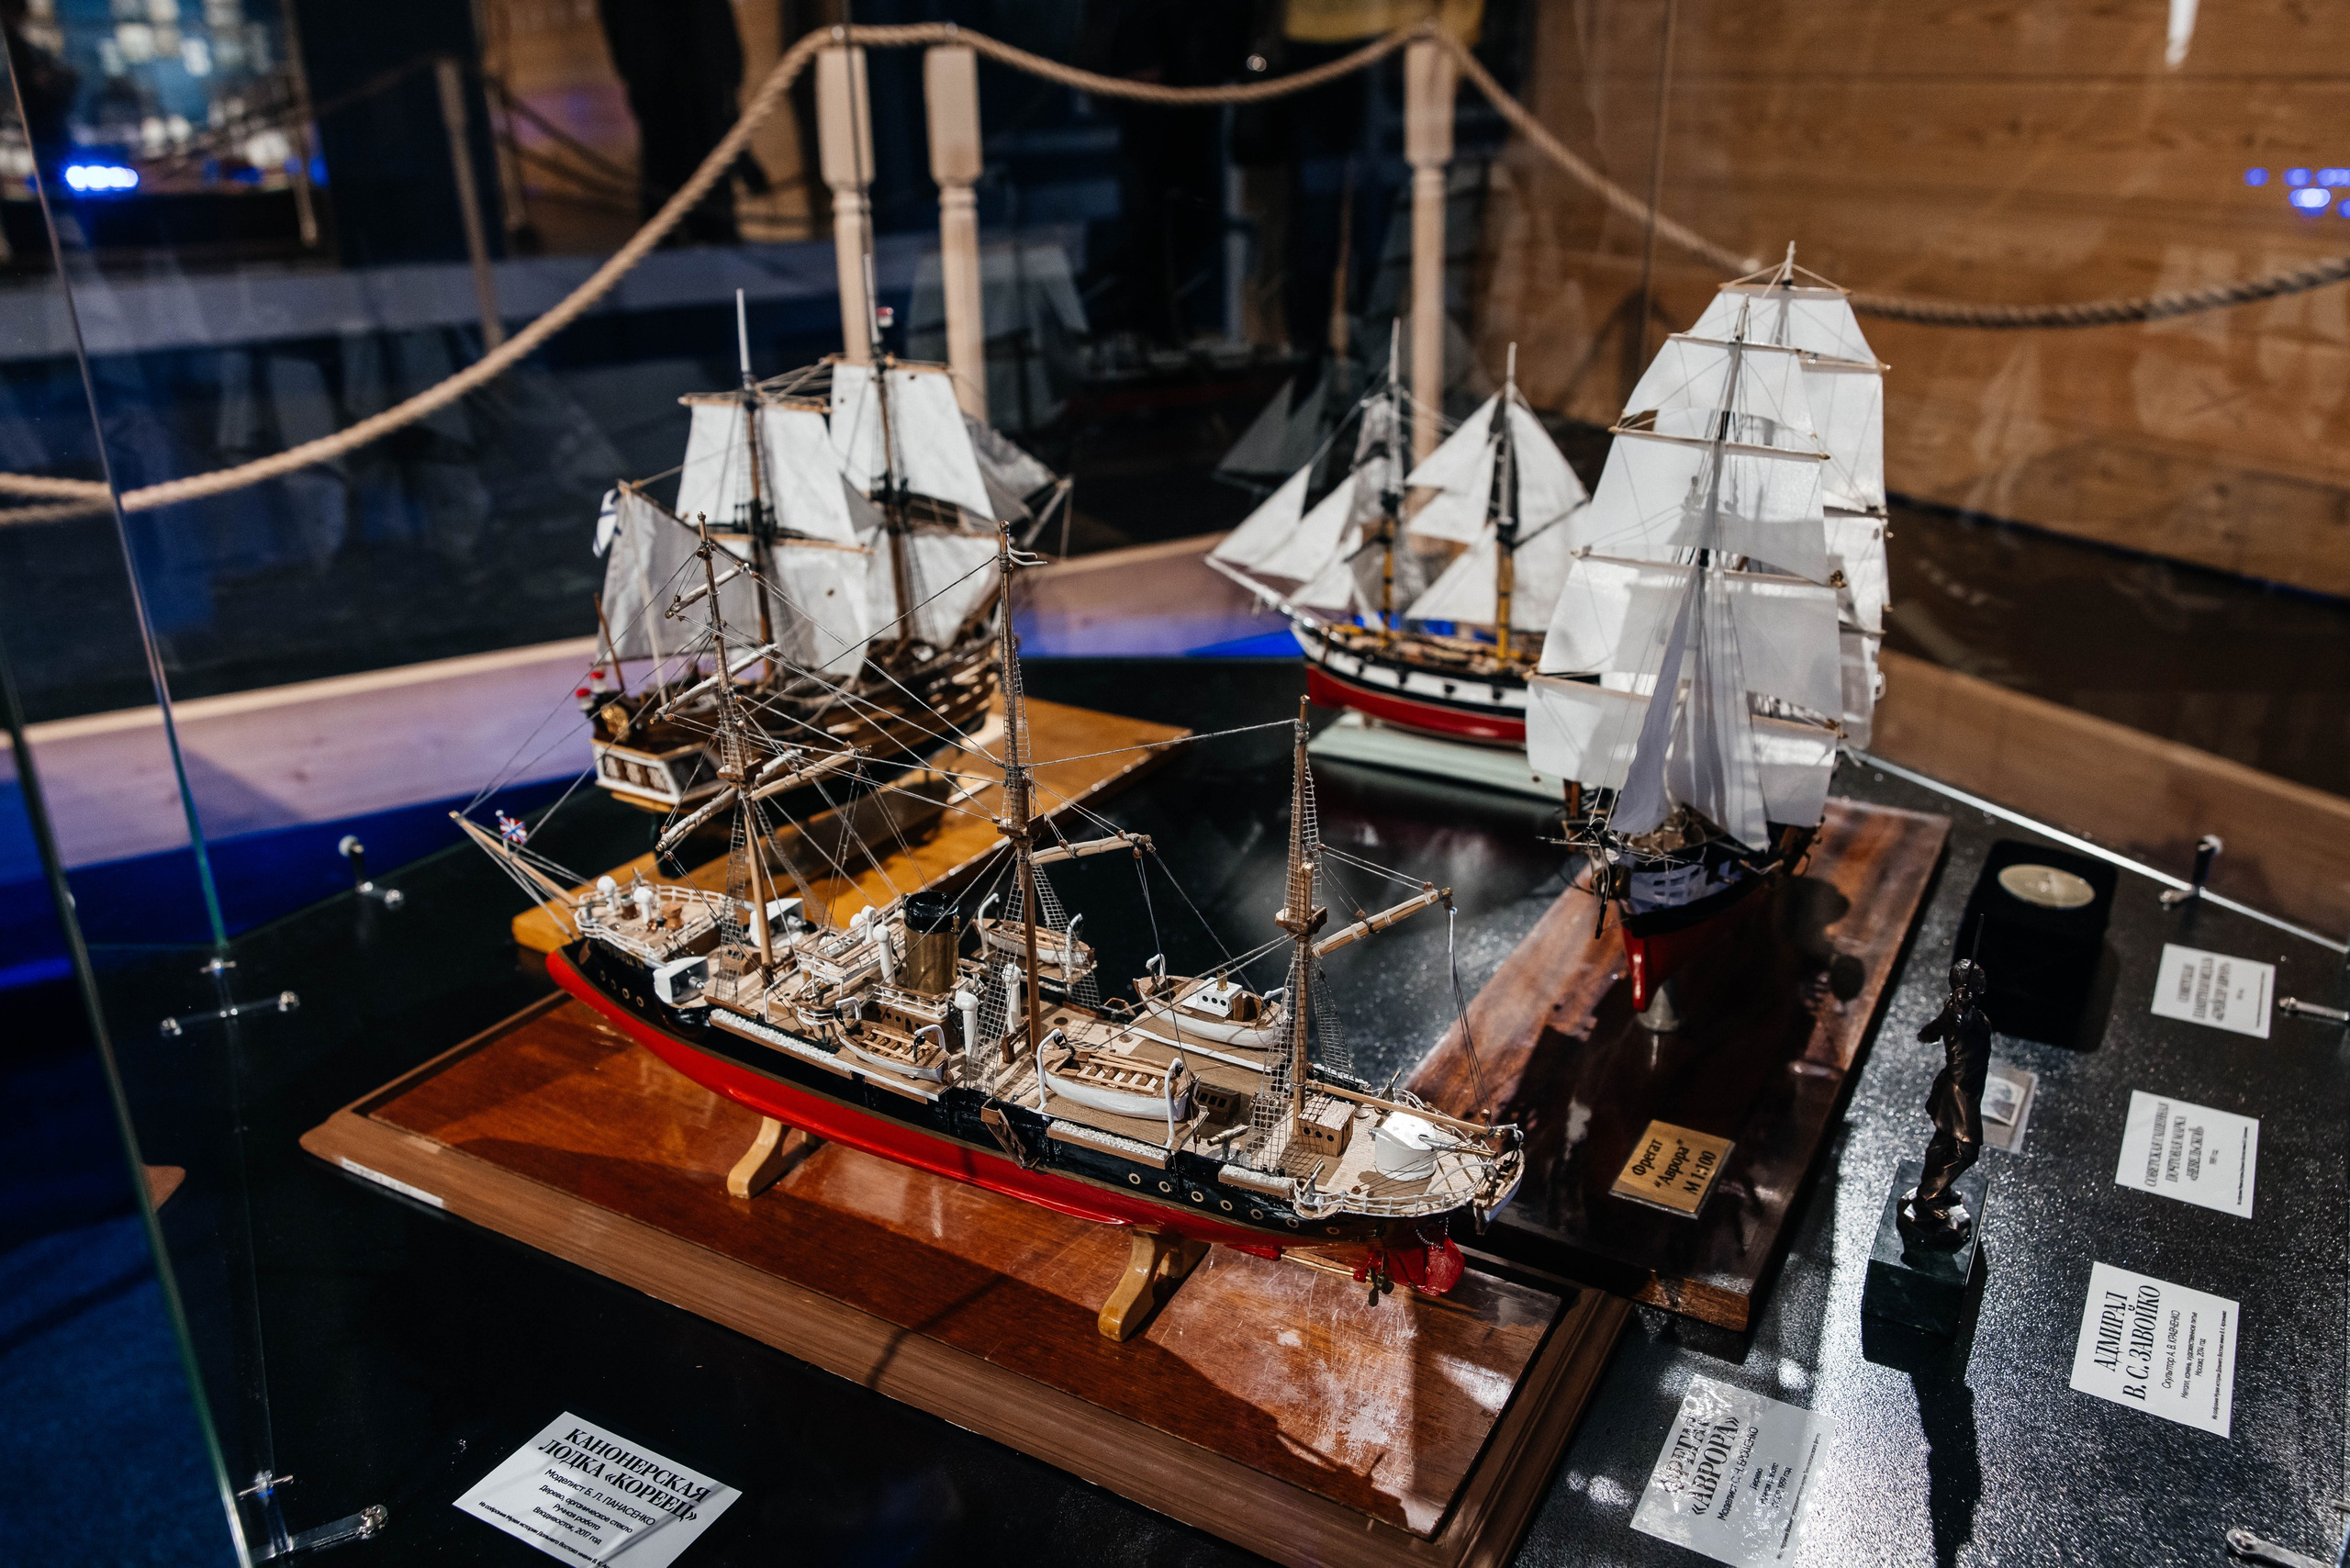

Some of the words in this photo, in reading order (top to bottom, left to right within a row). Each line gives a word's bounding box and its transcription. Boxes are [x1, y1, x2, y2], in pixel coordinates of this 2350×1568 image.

[1631, 1138, 1662, 1175] Фрегат
[1690, 1150, 1716, 1180] 1:100
[1682, 1180, 1701, 1194] М
[2094, 1291, 2127, 1372] АДМИРАЛ
[2128, 1285, 2160, 1361] ЗАВОЙКО
[2167, 1309, 2180, 1343] КРАВЧЕНКО
[2125, 1365, 2149, 1379] С.
[2161, 1356, 2176, 1388] Скульптор
[2122, 1384, 2146, 1400] В.
[538, 1439, 605, 1477] ЛОДКА
[604, 1473, 696, 1521] «КОРЕЕЦ»
[565, 1428, 711, 1502] КАНОНЕРСКАЯ
[1690, 1417, 1740, 1516] «АВРОРА»
[538, 1484, 565, 1501] Дерево,
[565, 1497, 610, 1522] органическое
[609, 1519, 632, 1533] стекло
[544, 1468, 586, 1492] Моделист
[583, 1487, 593, 1496] Б.
[591, 1492, 603, 1501] Л.
[601, 1496, 655, 1527] ПАНАСЕНКО
[1717, 1484, 1737, 1520] Моделист
[532, 1506, 574, 1531] Владивосток,
[574, 1527, 591, 1538] 2017
[588, 1535, 602, 1545] год
[552, 1503, 576, 1518] Ручная
[574, 1515, 600, 1530] работа
